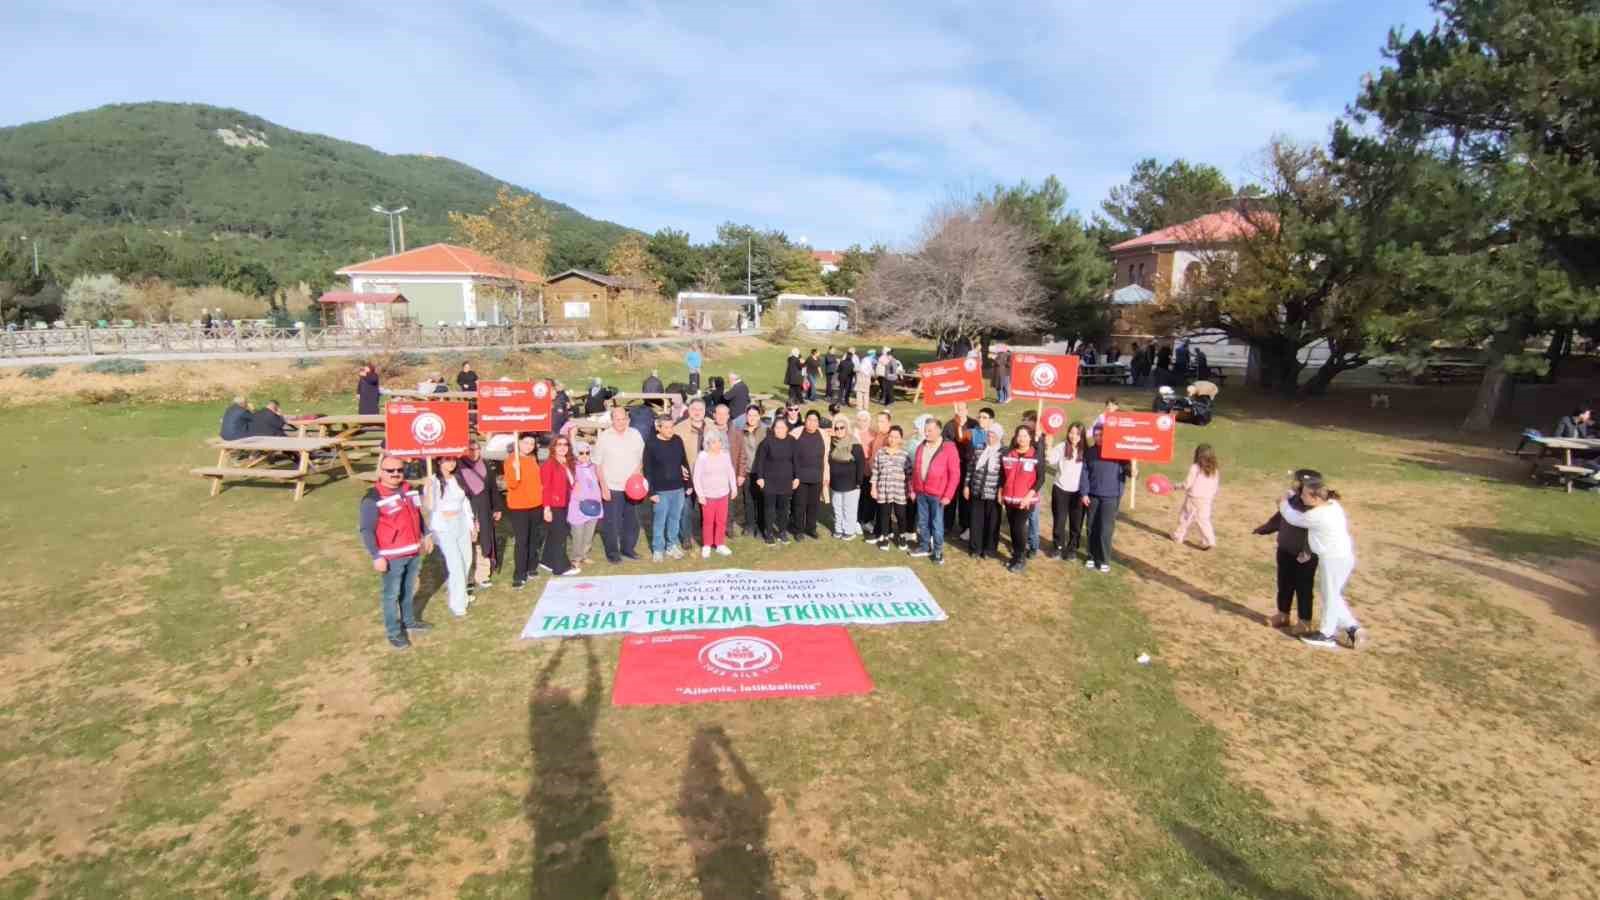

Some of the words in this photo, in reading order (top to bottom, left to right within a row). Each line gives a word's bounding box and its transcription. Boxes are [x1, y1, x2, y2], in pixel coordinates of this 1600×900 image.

[730, 592, 774, 601] PARK
[541, 609, 633, 631] TABİAT
[646, 602, 753, 625] TURİZMİ
[767, 598, 935, 623] ETKİNLİKLERİ
